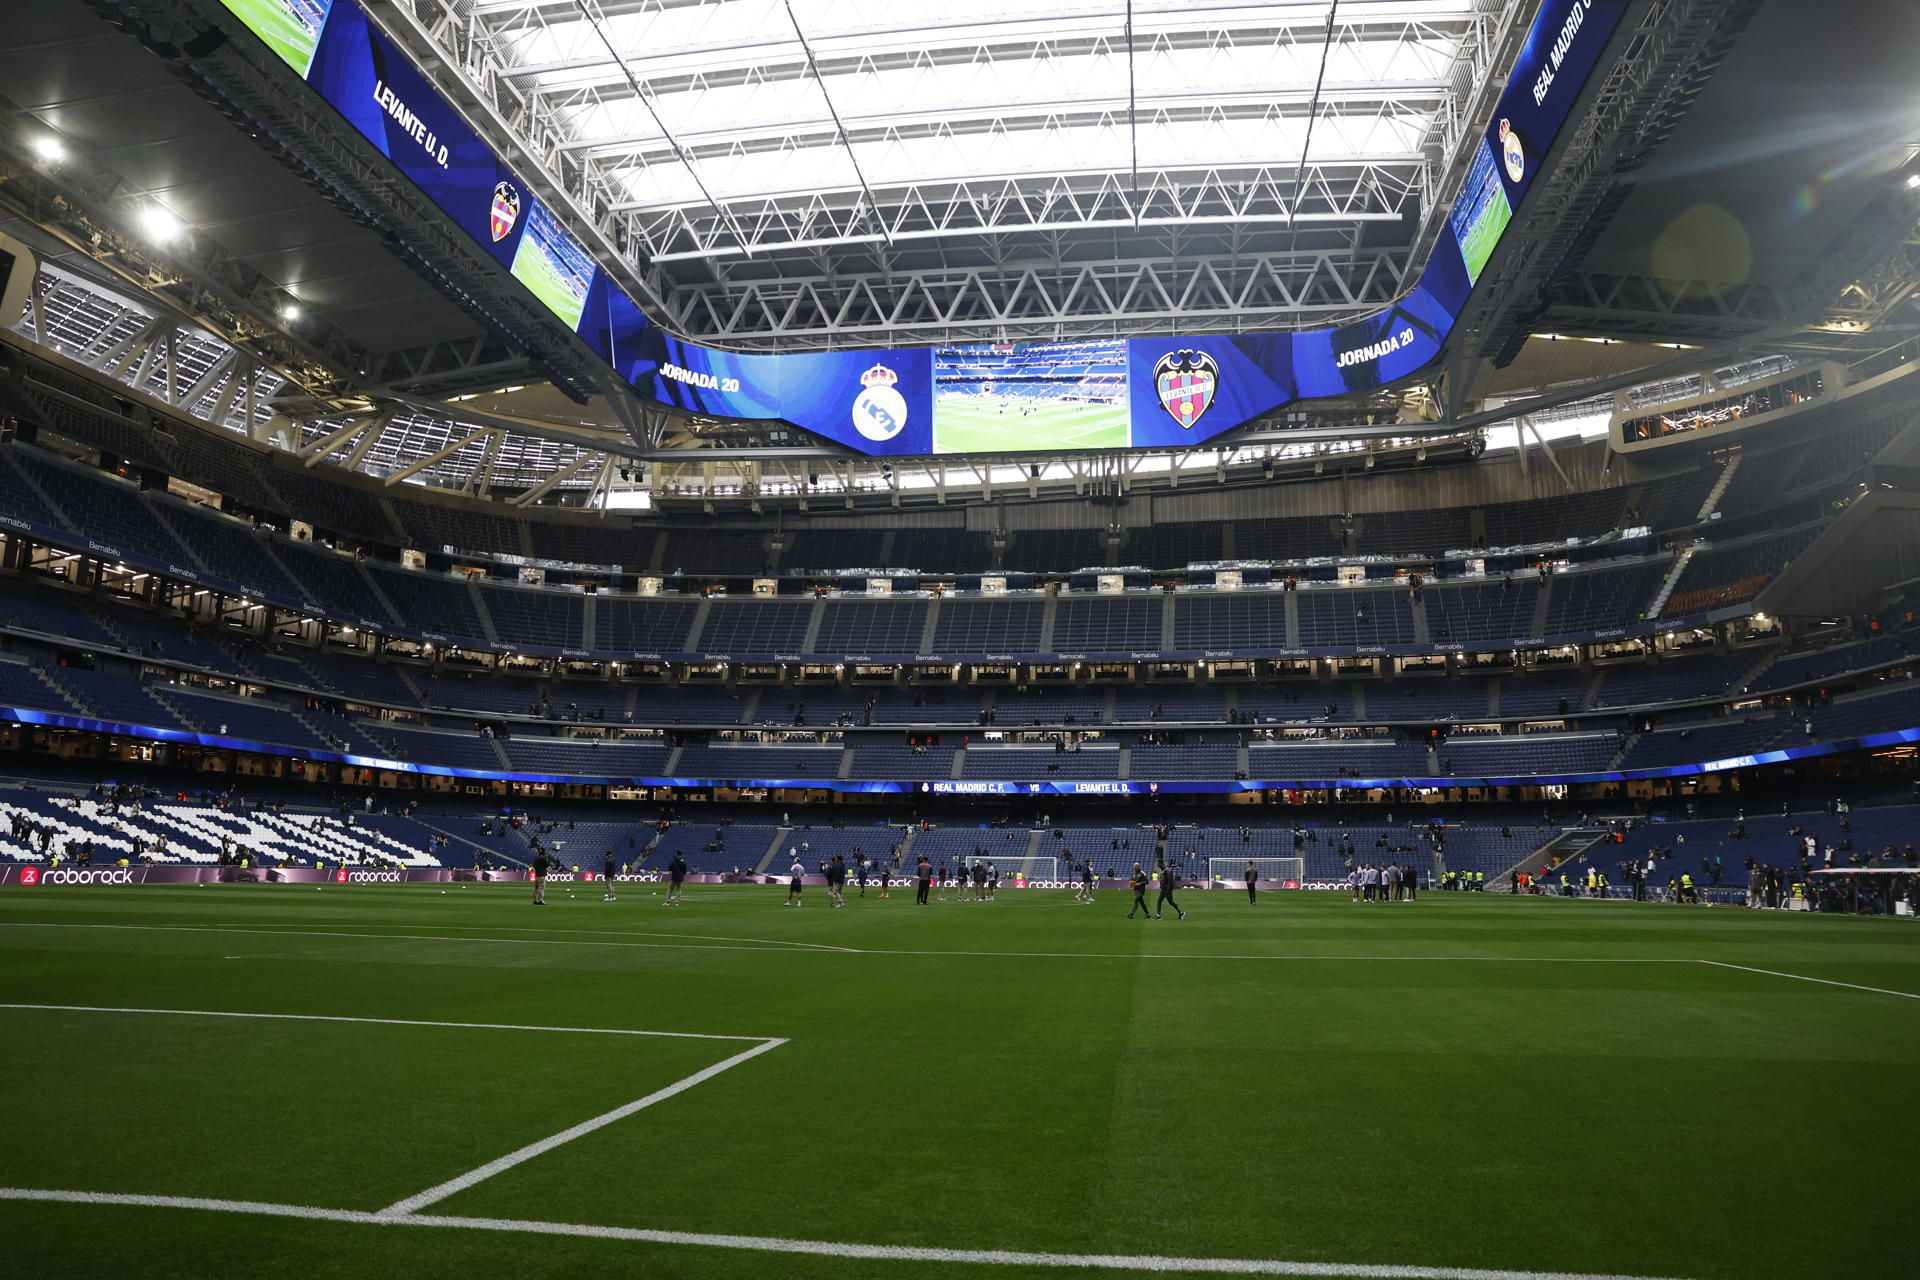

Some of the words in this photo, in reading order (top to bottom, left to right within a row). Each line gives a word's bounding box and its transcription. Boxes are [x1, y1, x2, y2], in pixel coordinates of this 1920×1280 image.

[1532, 63, 1555, 107] REAL
[1550, 1, 1584, 71] MADRID
[373, 80, 427, 145] LEVANTE
[425, 132, 437, 157] U.
[437, 144, 449, 169] D.
[1336, 336, 1400, 368] JORNADA
[1400, 328, 1414, 347] 20
[659, 362, 719, 390] JORNADA
[721, 377, 740, 393] 20
[0, 515, 32, 531] ernabéu
[89, 540, 121, 557] Bernabéu
[169, 564, 198, 579] Bernabéu
[303, 602, 326, 615] Bernabéu
[359, 618, 383, 630] Bernabéu
[1655, 618, 1684, 630] Bernabéu
[421, 631, 447, 642] Bernabéu
[1595, 627, 1625, 638] Bernabéu
[490, 641, 517, 651] Bernabéu
[1434, 641, 1464, 650] Bernabéu
[1514, 637, 1544, 647] Bernabéu
[562, 648, 590, 657] Bernabéu
[1205, 649, 1233, 657] Bernabéu
[1280, 648, 1308, 656] Bernabéu
[1356, 645, 1385, 653] Bernabéu
[634, 652, 661, 660] Bernabéu
[704, 653, 731, 661] Bernabéu
[774, 653, 801, 661] Bernabéu
[844, 654, 871, 662] Bernabéu
[915, 654, 942, 662] Bernabéu
[986, 653, 1014, 661] Bernabéu
[1131, 651, 1159, 659] Bernabéu
[359, 757, 376, 768] REAL
[1704, 762, 1717, 772] REAL
[933, 783, 954, 792] REAL
[956, 783, 987, 792] MADRID
[989, 783, 997, 792] C.
[998, 783, 1005, 792] F.
[1030, 784, 1040, 792] VS
[1075, 783, 1110, 792] LEVANTE
[1112, 784, 1121, 792] U.
[1121, 784, 1130, 792] D.
[41, 867, 134, 885] roborock
[348, 869, 401, 883] roborock
[544, 871, 575, 882] borock
